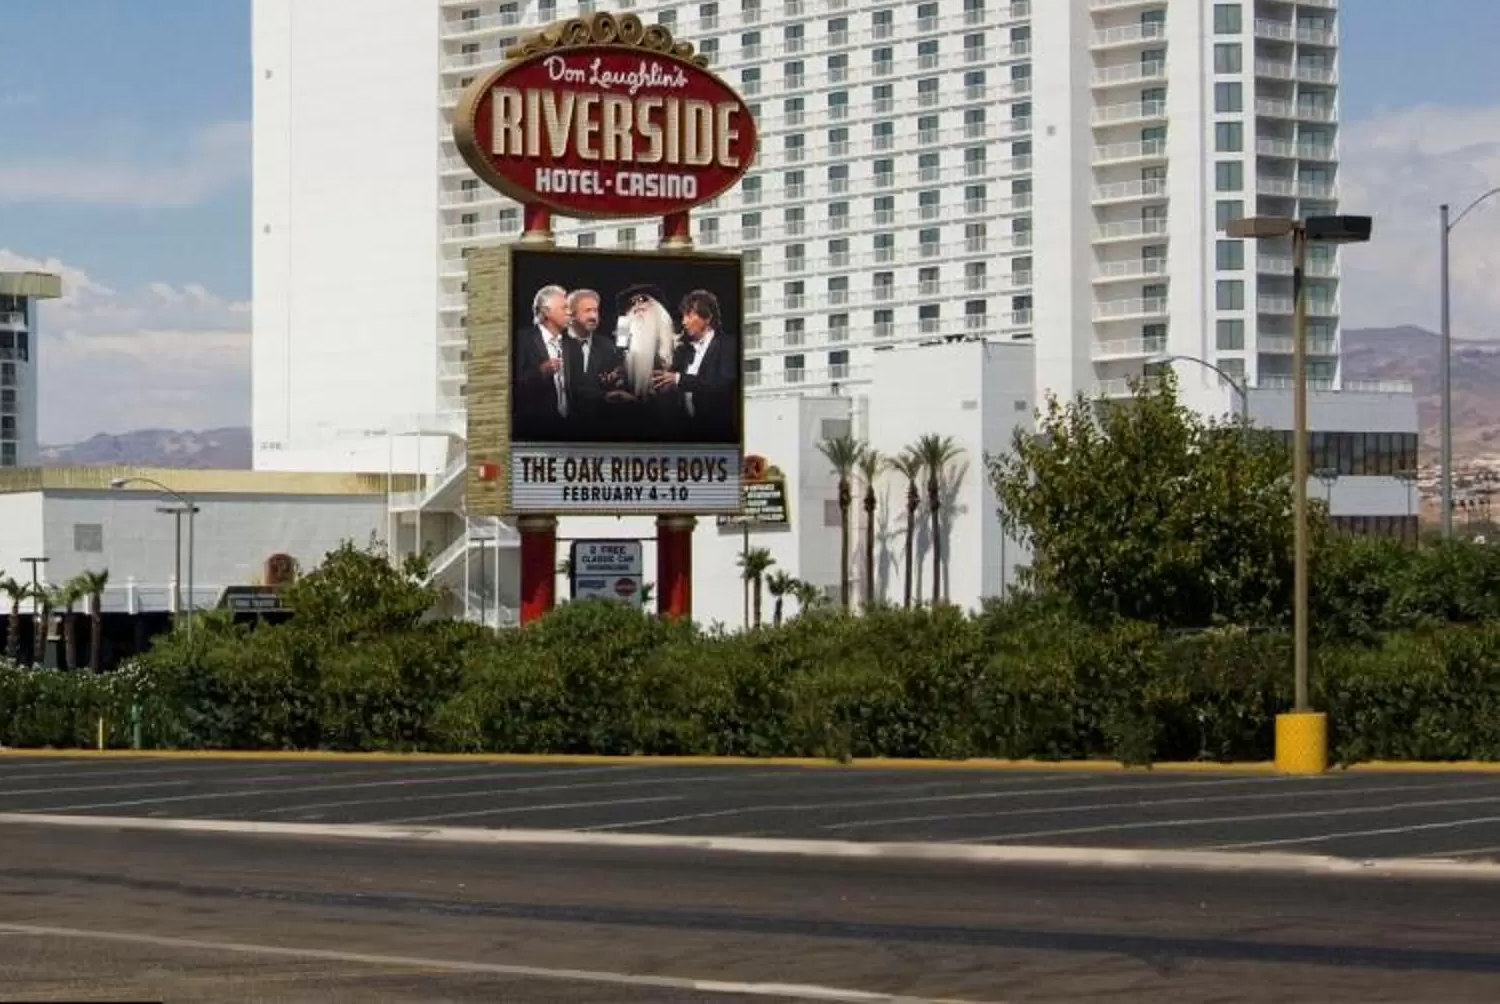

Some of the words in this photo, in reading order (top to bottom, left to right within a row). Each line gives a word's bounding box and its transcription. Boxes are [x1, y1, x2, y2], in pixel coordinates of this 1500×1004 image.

[543, 55, 586, 83] Don
[589, 57, 688, 94] Laughlin's
[491, 87, 741, 168] RIVERSIDE
[521, 456, 557, 482] THE
[563, 456, 604, 483] OAK
[611, 457, 670, 483] RIDGE
[677, 457, 729, 483] BOYS
[563, 486, 644, 501] FEBRUARY
[648, 486, 690, 501] 4-10
